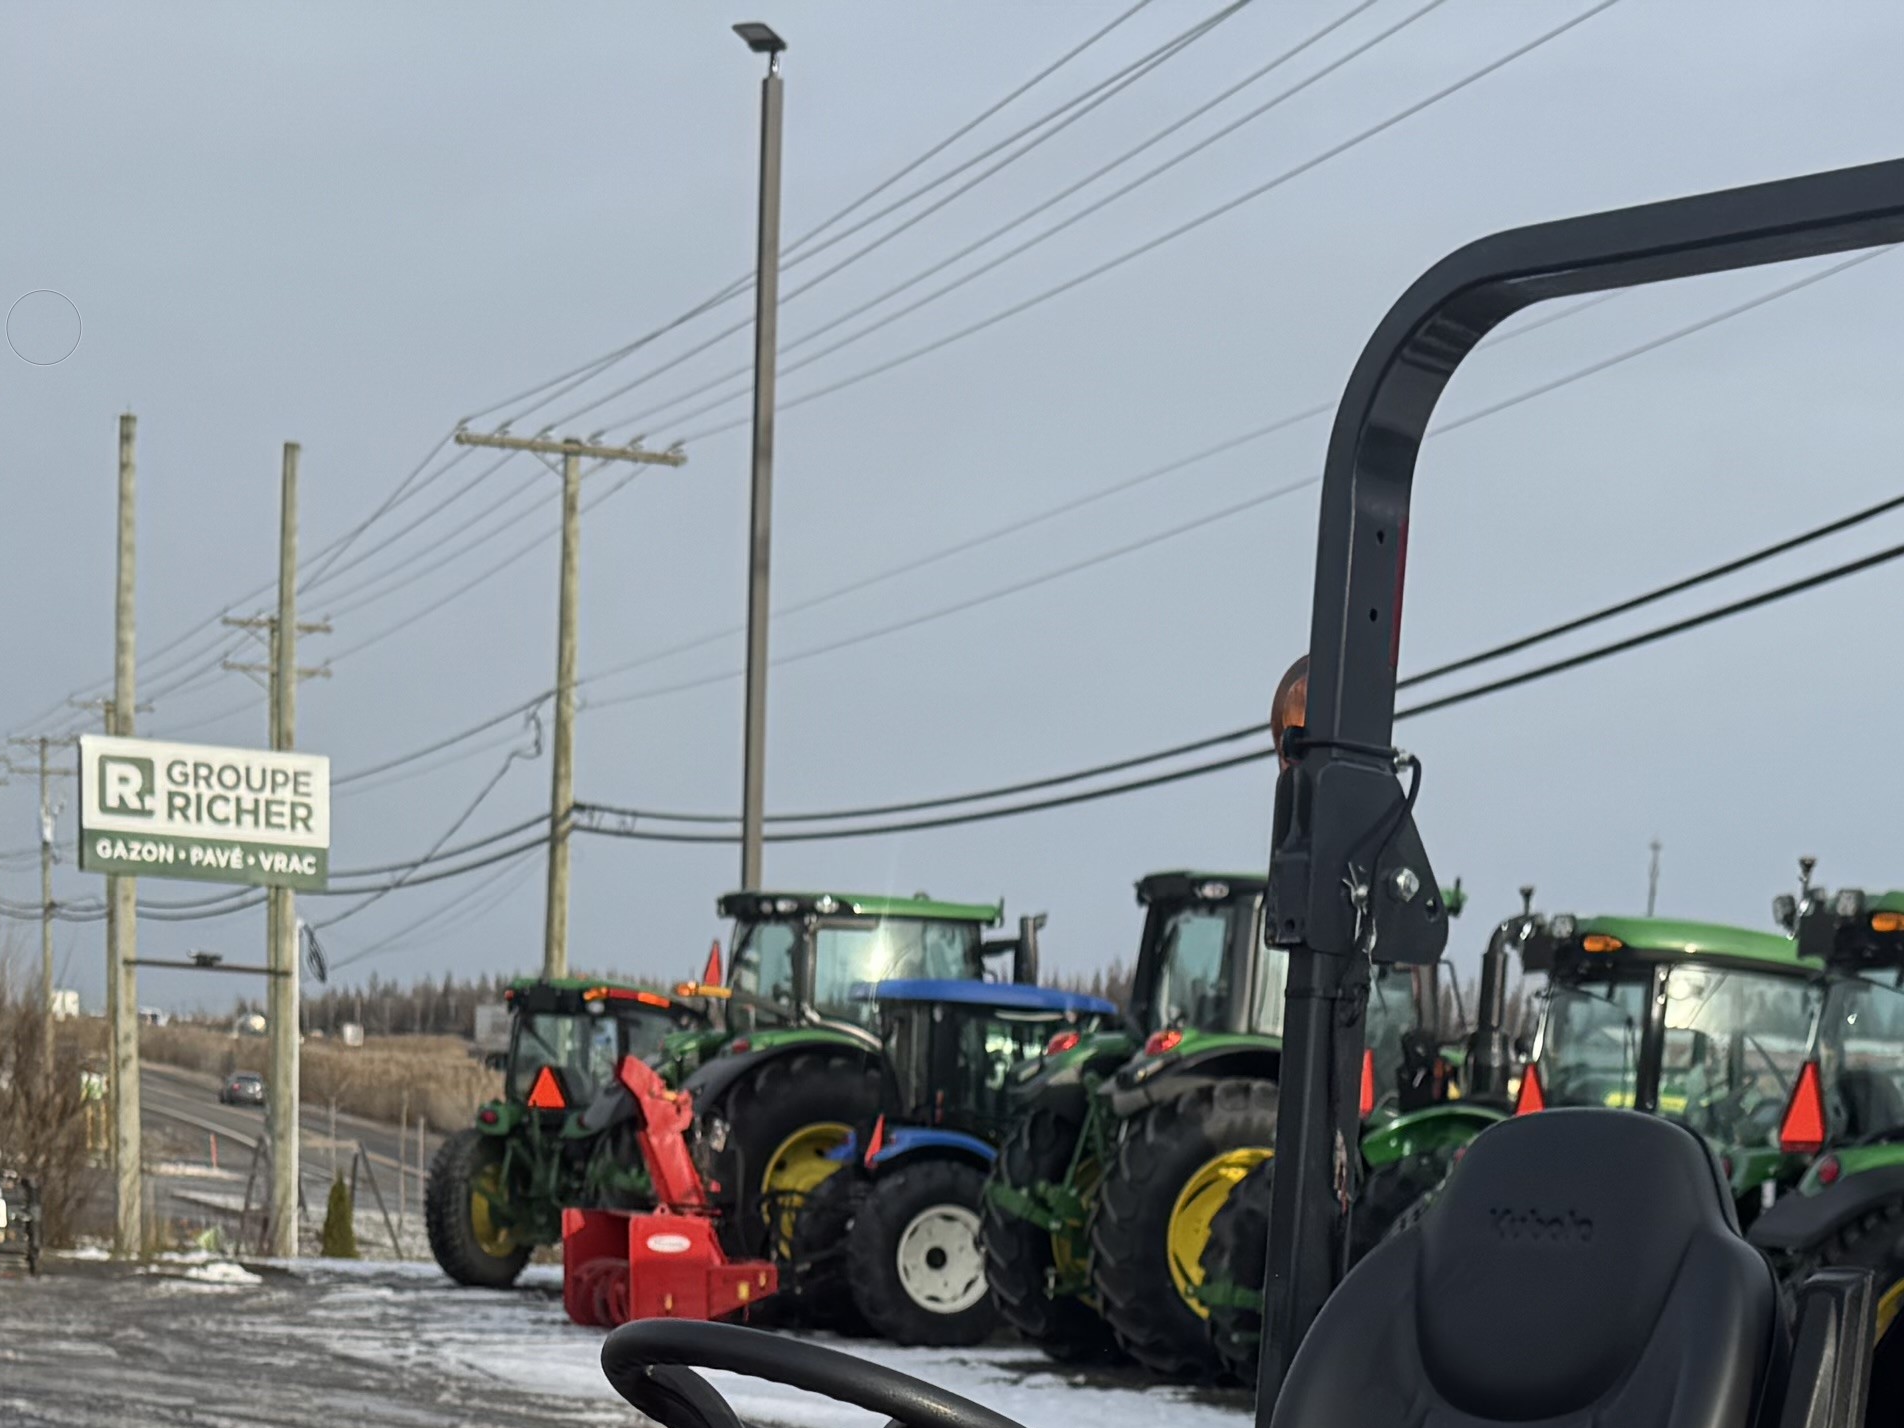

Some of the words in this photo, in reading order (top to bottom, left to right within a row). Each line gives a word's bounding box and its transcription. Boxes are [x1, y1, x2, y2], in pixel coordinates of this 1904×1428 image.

[166, 759, 313, 798] GROUPE
[167, 791, 314, 833] RICHER
[96, 838, 175, 865] GAZON
[190, 845, 244, 870] PAVÉ
[259, 852, 317, 876] VRAC
